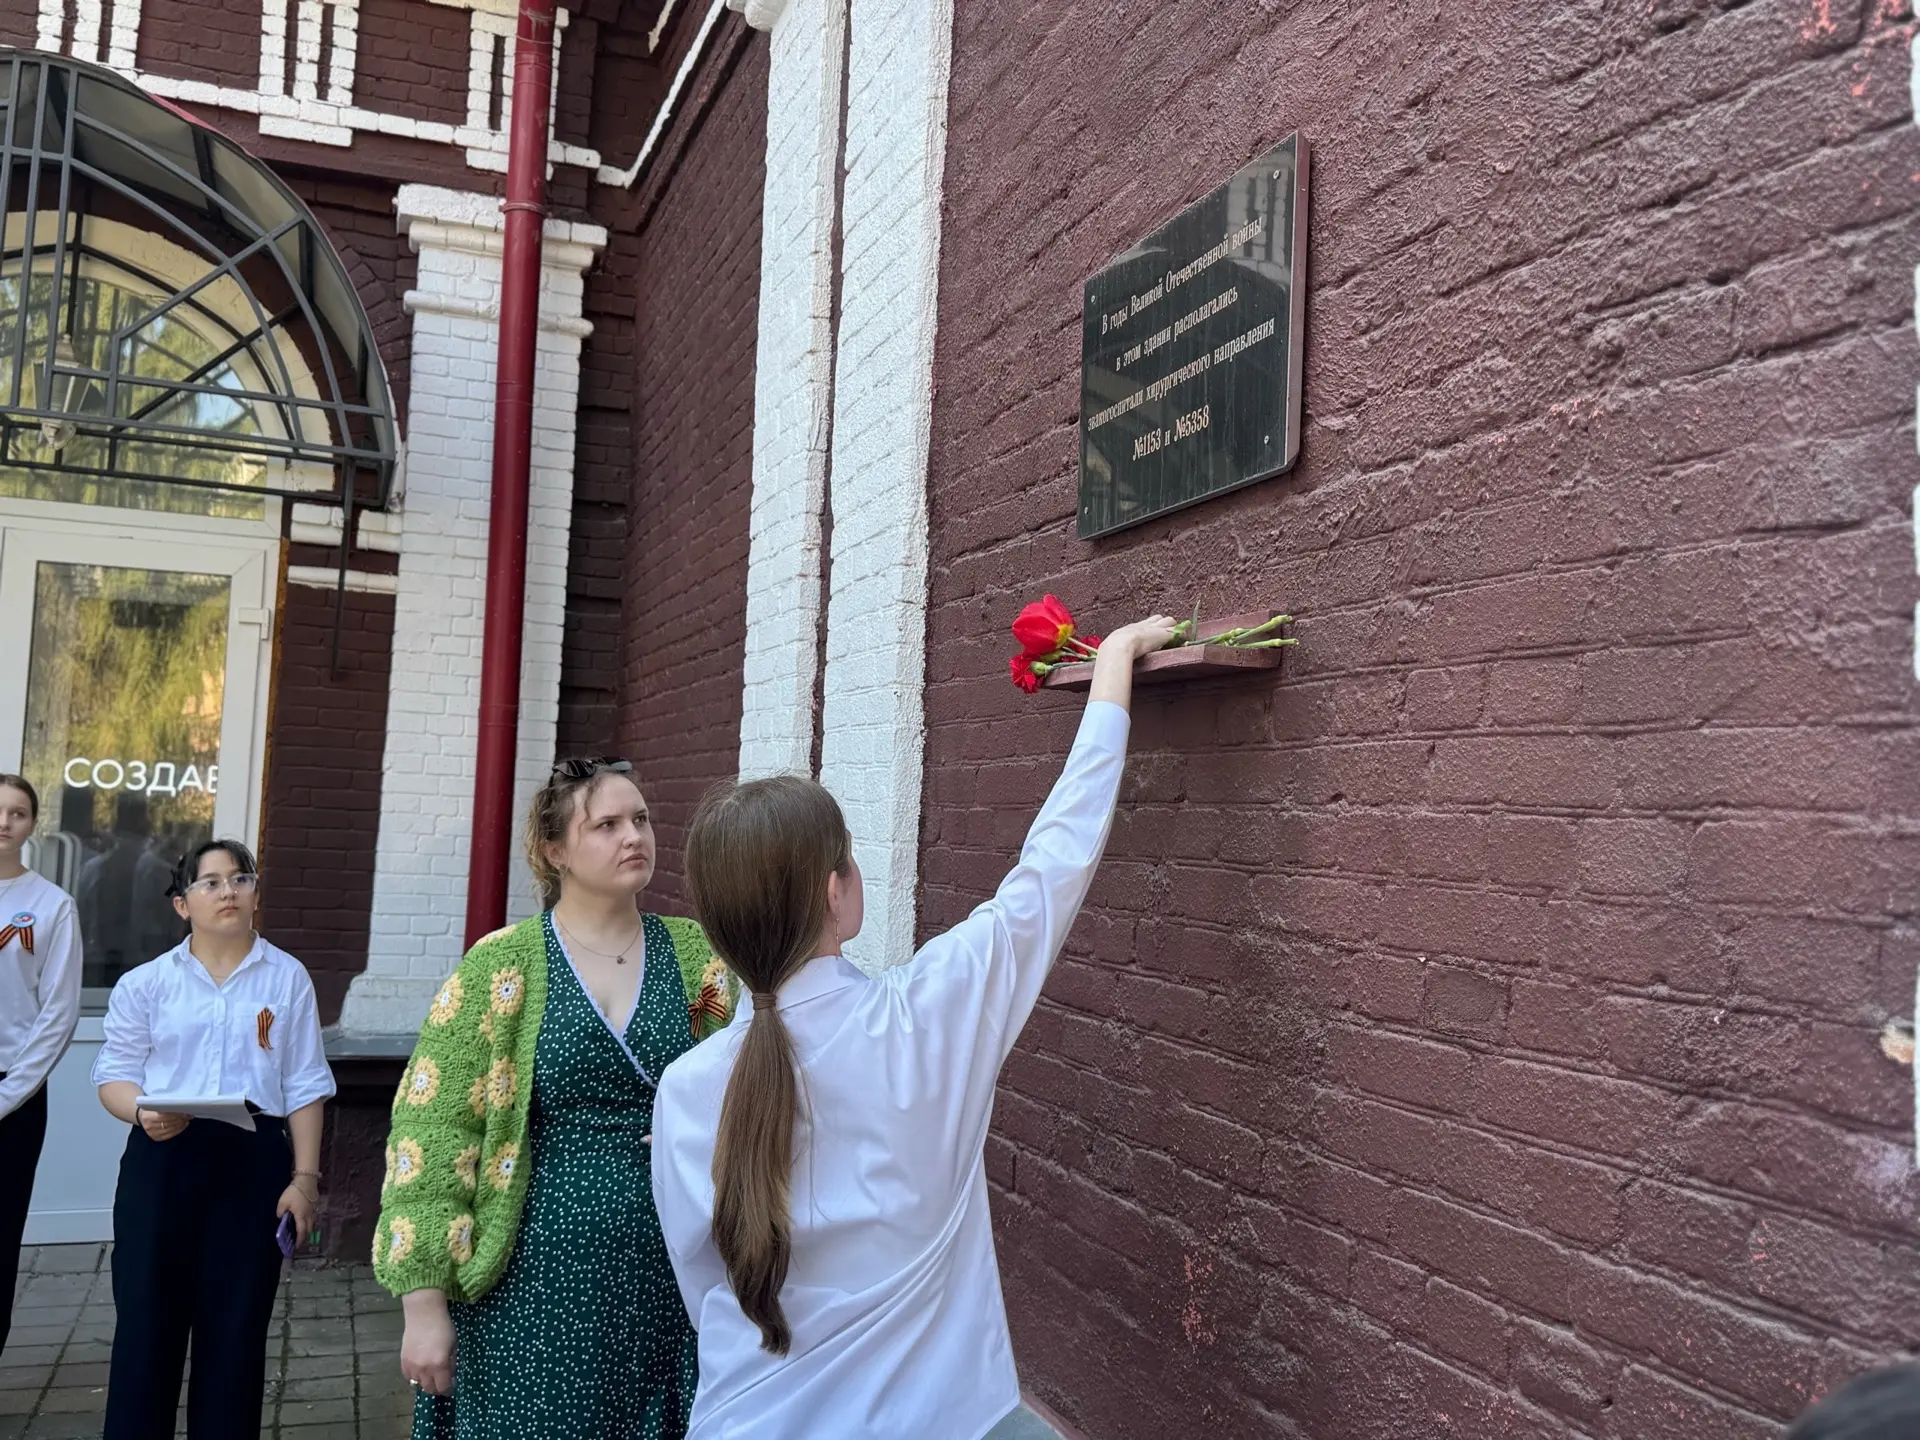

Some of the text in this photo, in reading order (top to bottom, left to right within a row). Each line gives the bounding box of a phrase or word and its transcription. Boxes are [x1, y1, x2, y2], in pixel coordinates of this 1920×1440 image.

[1102, 217, 1262, 335] В годы Великой Отечественной войны
[1088, 318, 1275, 431] эвакогоспитали хирургического направления
[1116, 286, 1238, 372] в этом здании располагались
[1133, 404, 1209, 461] №1153 и №5358
